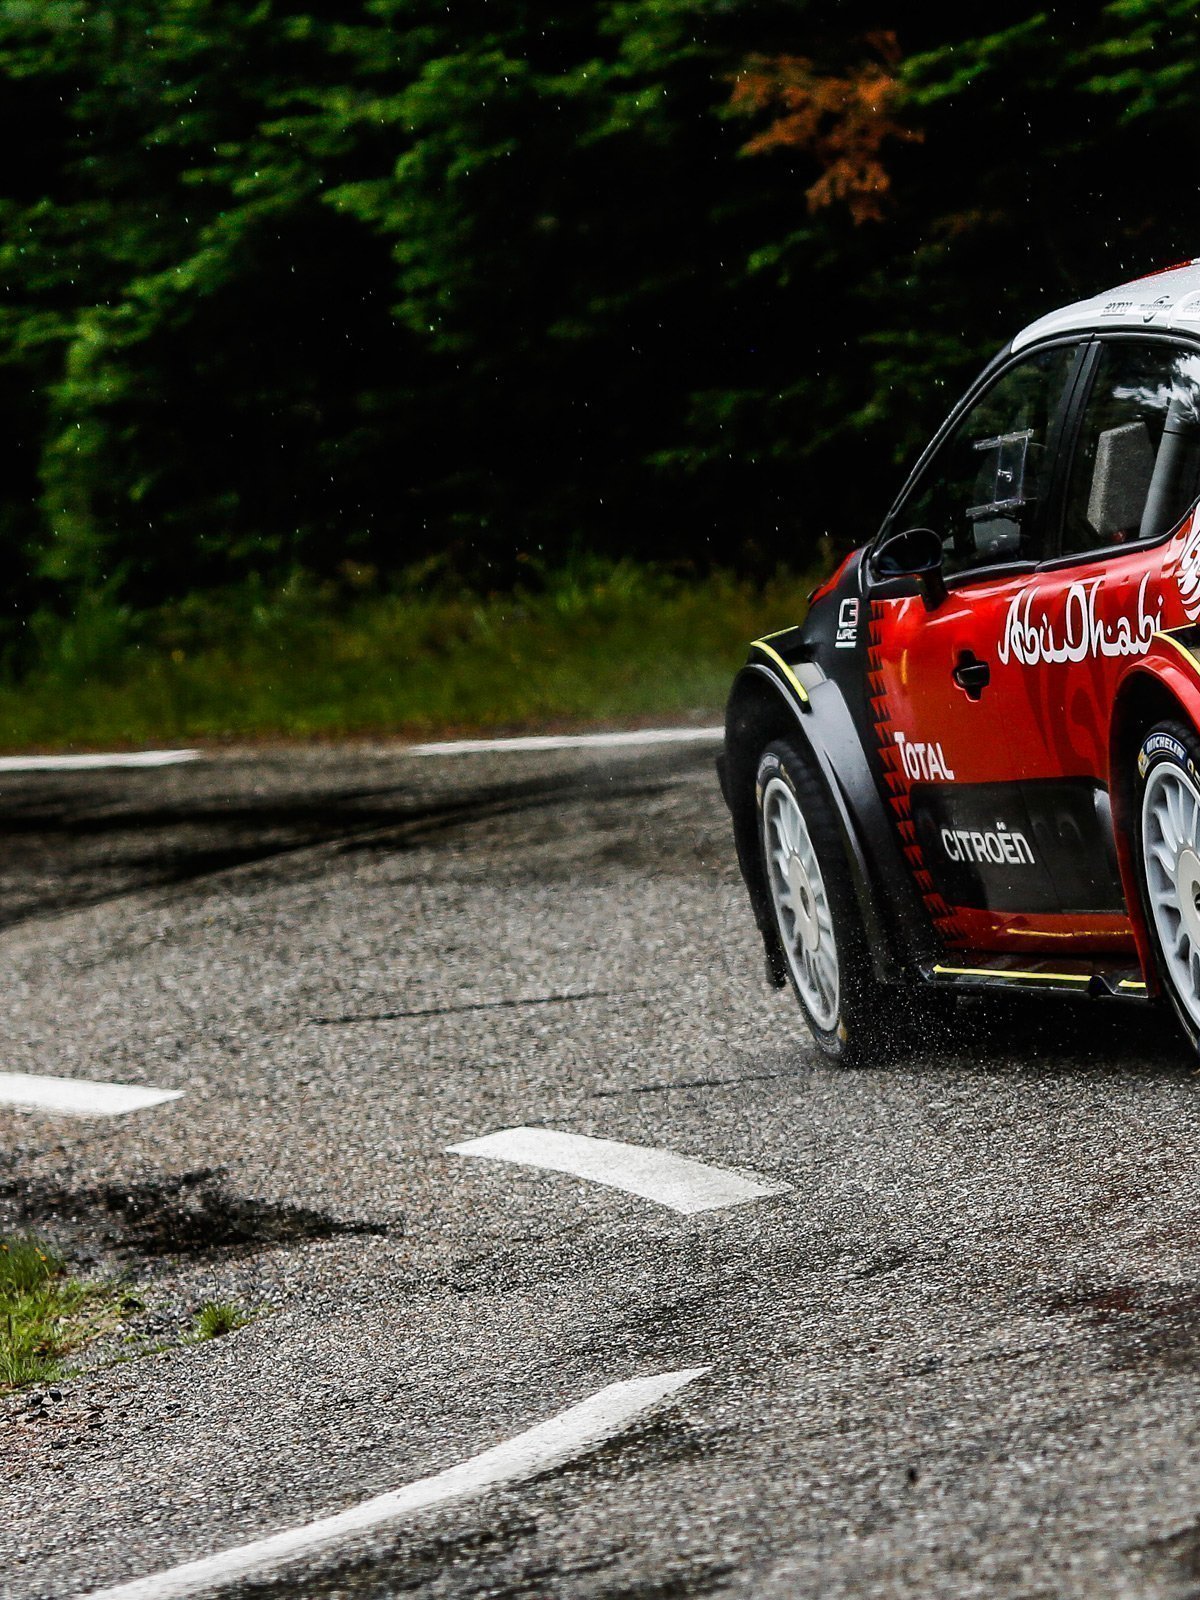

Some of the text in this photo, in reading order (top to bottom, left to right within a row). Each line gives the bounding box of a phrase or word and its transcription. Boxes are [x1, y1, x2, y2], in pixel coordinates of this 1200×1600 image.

[893, 731, 955, 781] TOTAL
[1146, 735, 1186, 761] MICHELIN
[941, 821, 1036, 864] CITROËN
